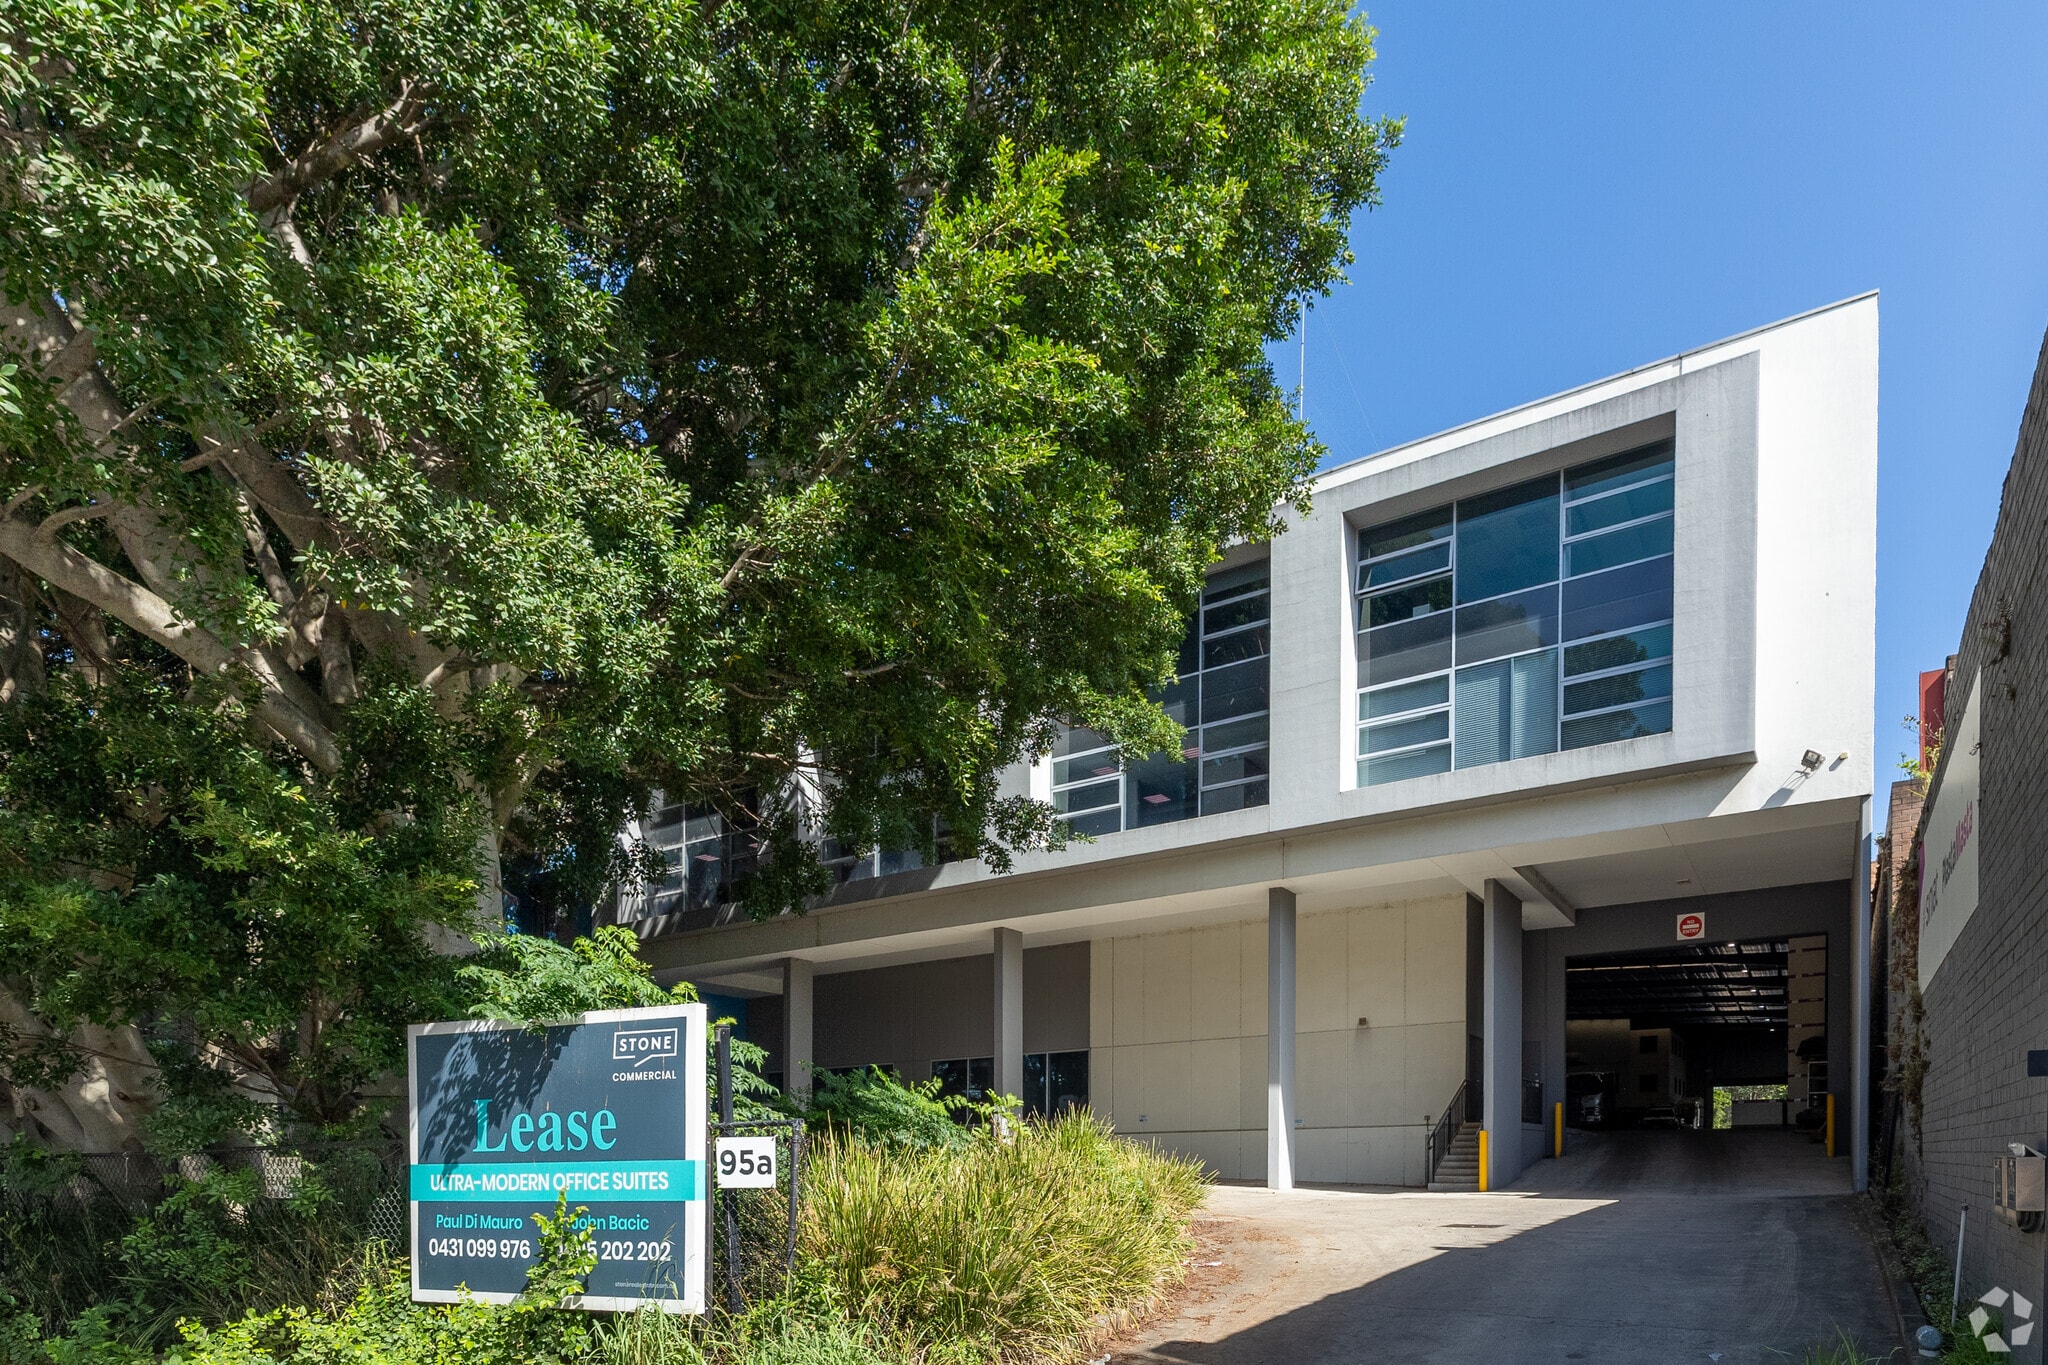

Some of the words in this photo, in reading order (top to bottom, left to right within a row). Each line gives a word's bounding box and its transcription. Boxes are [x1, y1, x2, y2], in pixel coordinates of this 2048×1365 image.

[619, 1035, 672, 1052] STONE
[612, 1070, 677, 1082] COMMERCIAL
[472, 1098, 618, 1154] Lease
[719, 1149, 773, 1176] 95a
[430, 1173, 549, 1192] ULTRA-MODERN
[552, 1172, 609, 1191] OFFICE
[612, 1171, 669, 1190] SUITES
[435, 1213, 463, 1229] Paul
[465, 1213, 478, 1229] Di
[480, 1214, 523, 1231] Mauro
[572, 1214, 606, 1230] John
[608, 1213, 650, 1231] Bacic
[428, 1238, 463, 1257] 0431
[466, 1238, 497, 1258] 099
[500, 1239, 531, 1259] 976
[601, 1240, 634, 1261] 202
[636, 1241, 671, 1261] 202
